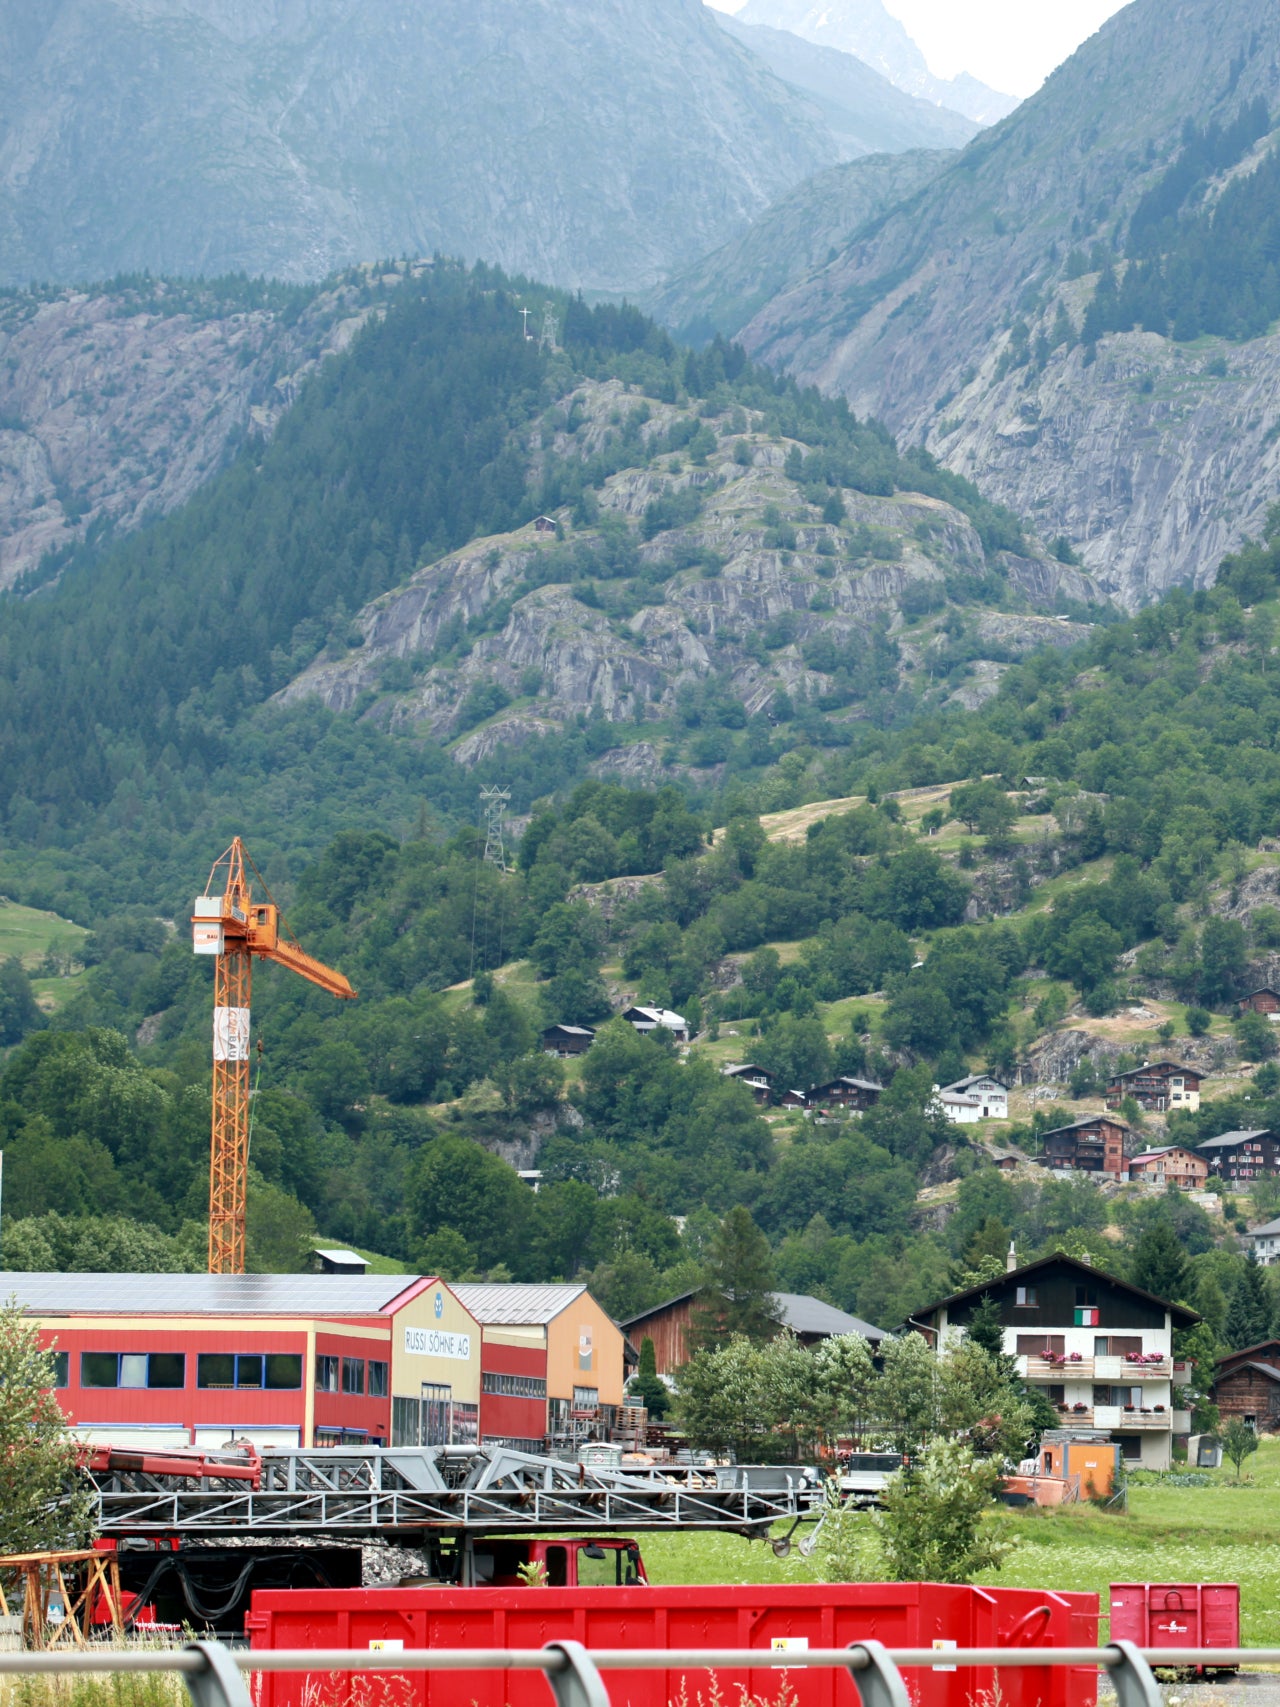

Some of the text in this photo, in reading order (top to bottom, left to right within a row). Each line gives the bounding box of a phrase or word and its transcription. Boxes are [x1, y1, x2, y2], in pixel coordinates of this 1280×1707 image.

[406, 1330, 469, 1356] RUSSI SÖHNE AG
